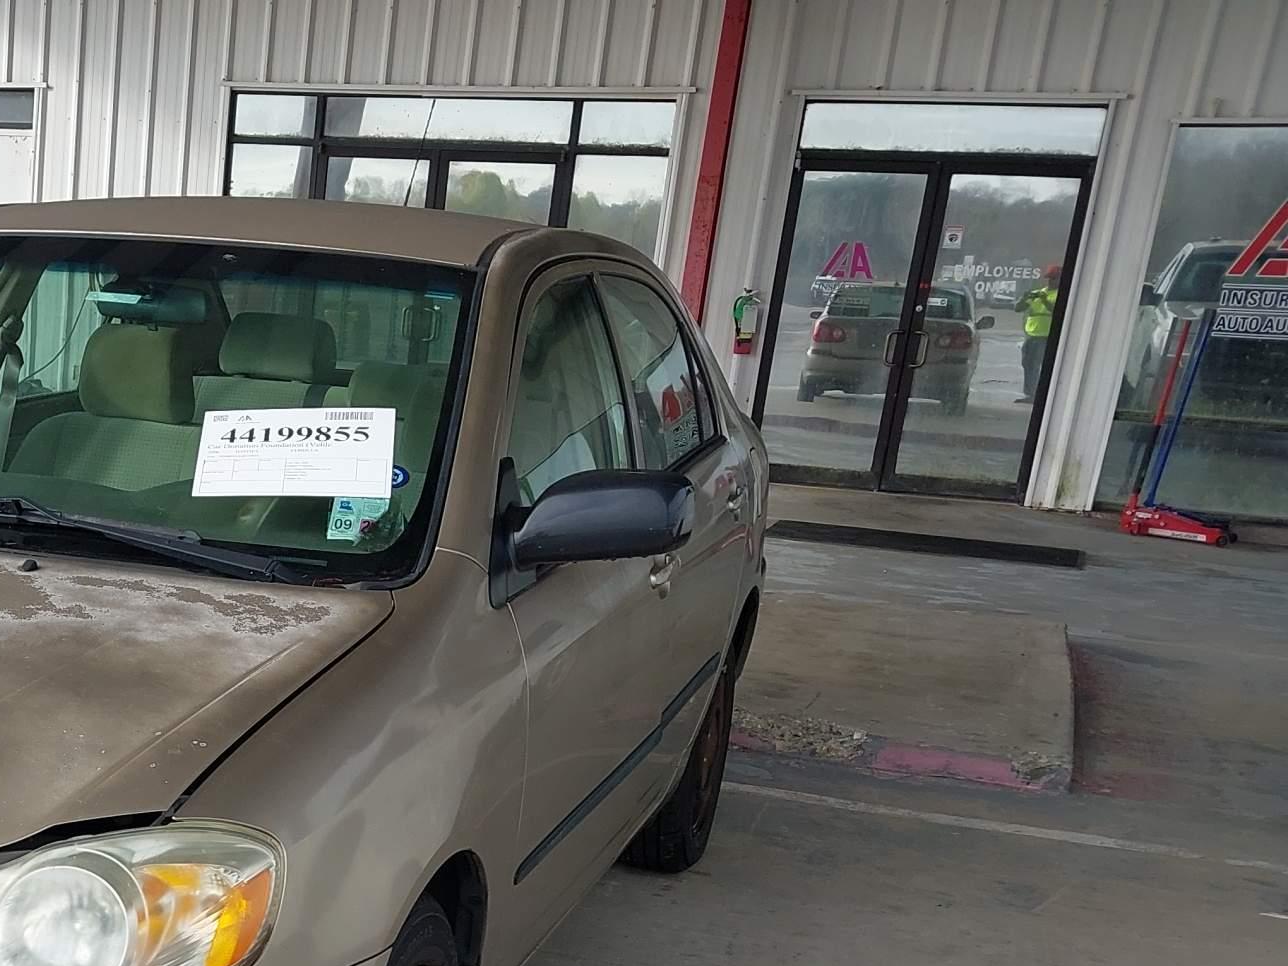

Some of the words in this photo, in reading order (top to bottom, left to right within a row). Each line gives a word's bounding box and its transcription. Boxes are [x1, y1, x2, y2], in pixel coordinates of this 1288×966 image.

[955, 264, 1041, 279] EMPLOYEES
[1213, 314, 1261, 332] AUTO
[220, 426, 370, 443] 44199855
[334, 519, 352, 530] 09
